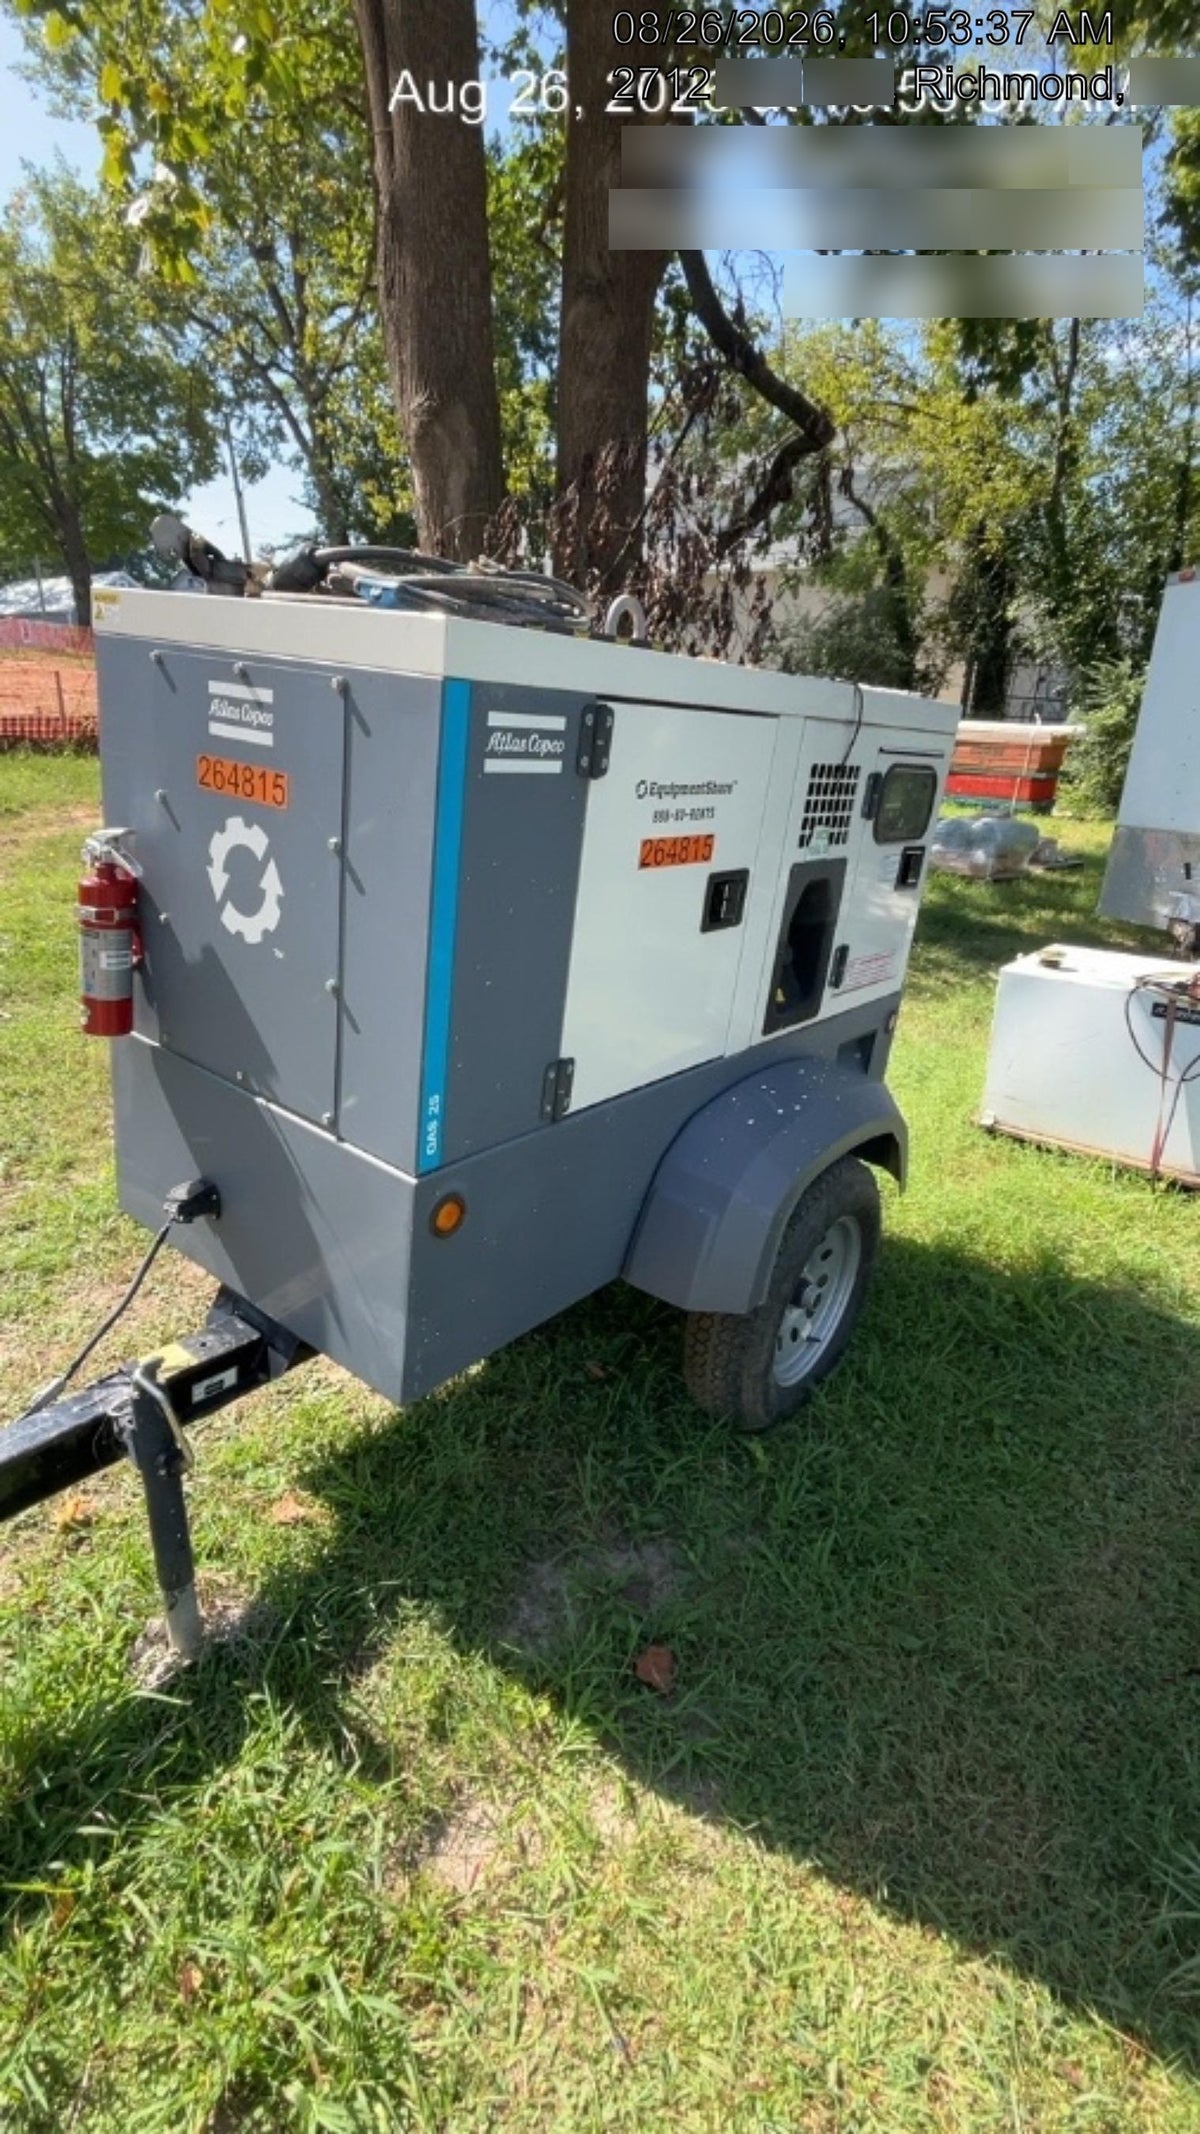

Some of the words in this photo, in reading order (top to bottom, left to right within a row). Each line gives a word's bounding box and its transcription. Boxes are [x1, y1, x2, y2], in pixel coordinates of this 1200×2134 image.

[208, 698, 240, 721] Atlas
[484, 731, 527, 755] Atlas
[528, 732, 565, 757] Copco
[198, 755, 286, 807] 264815
[640, 834, 714, 868] 264815
